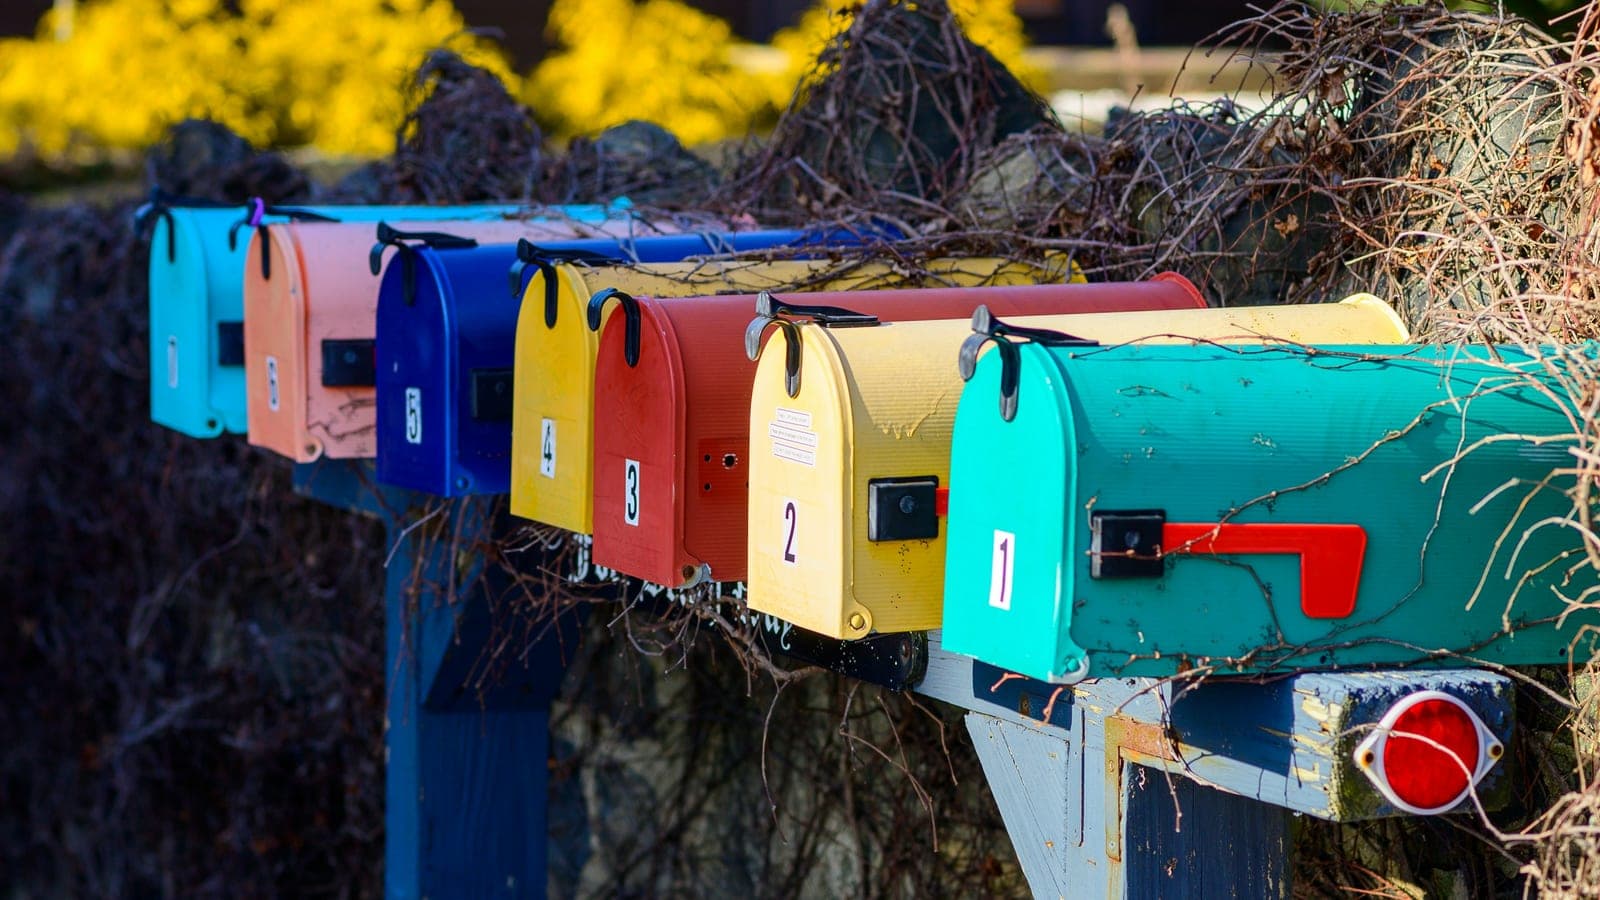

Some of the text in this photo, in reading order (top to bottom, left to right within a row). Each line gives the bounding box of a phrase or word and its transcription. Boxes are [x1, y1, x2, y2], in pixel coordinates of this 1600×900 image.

[408, 392, 418, 440] 5
[543, 421, 553, 472] 4
[627, 464, 638, 521] 3
[785, 501, 797, 563] 2
[999, 537, 1008, 603] 1
